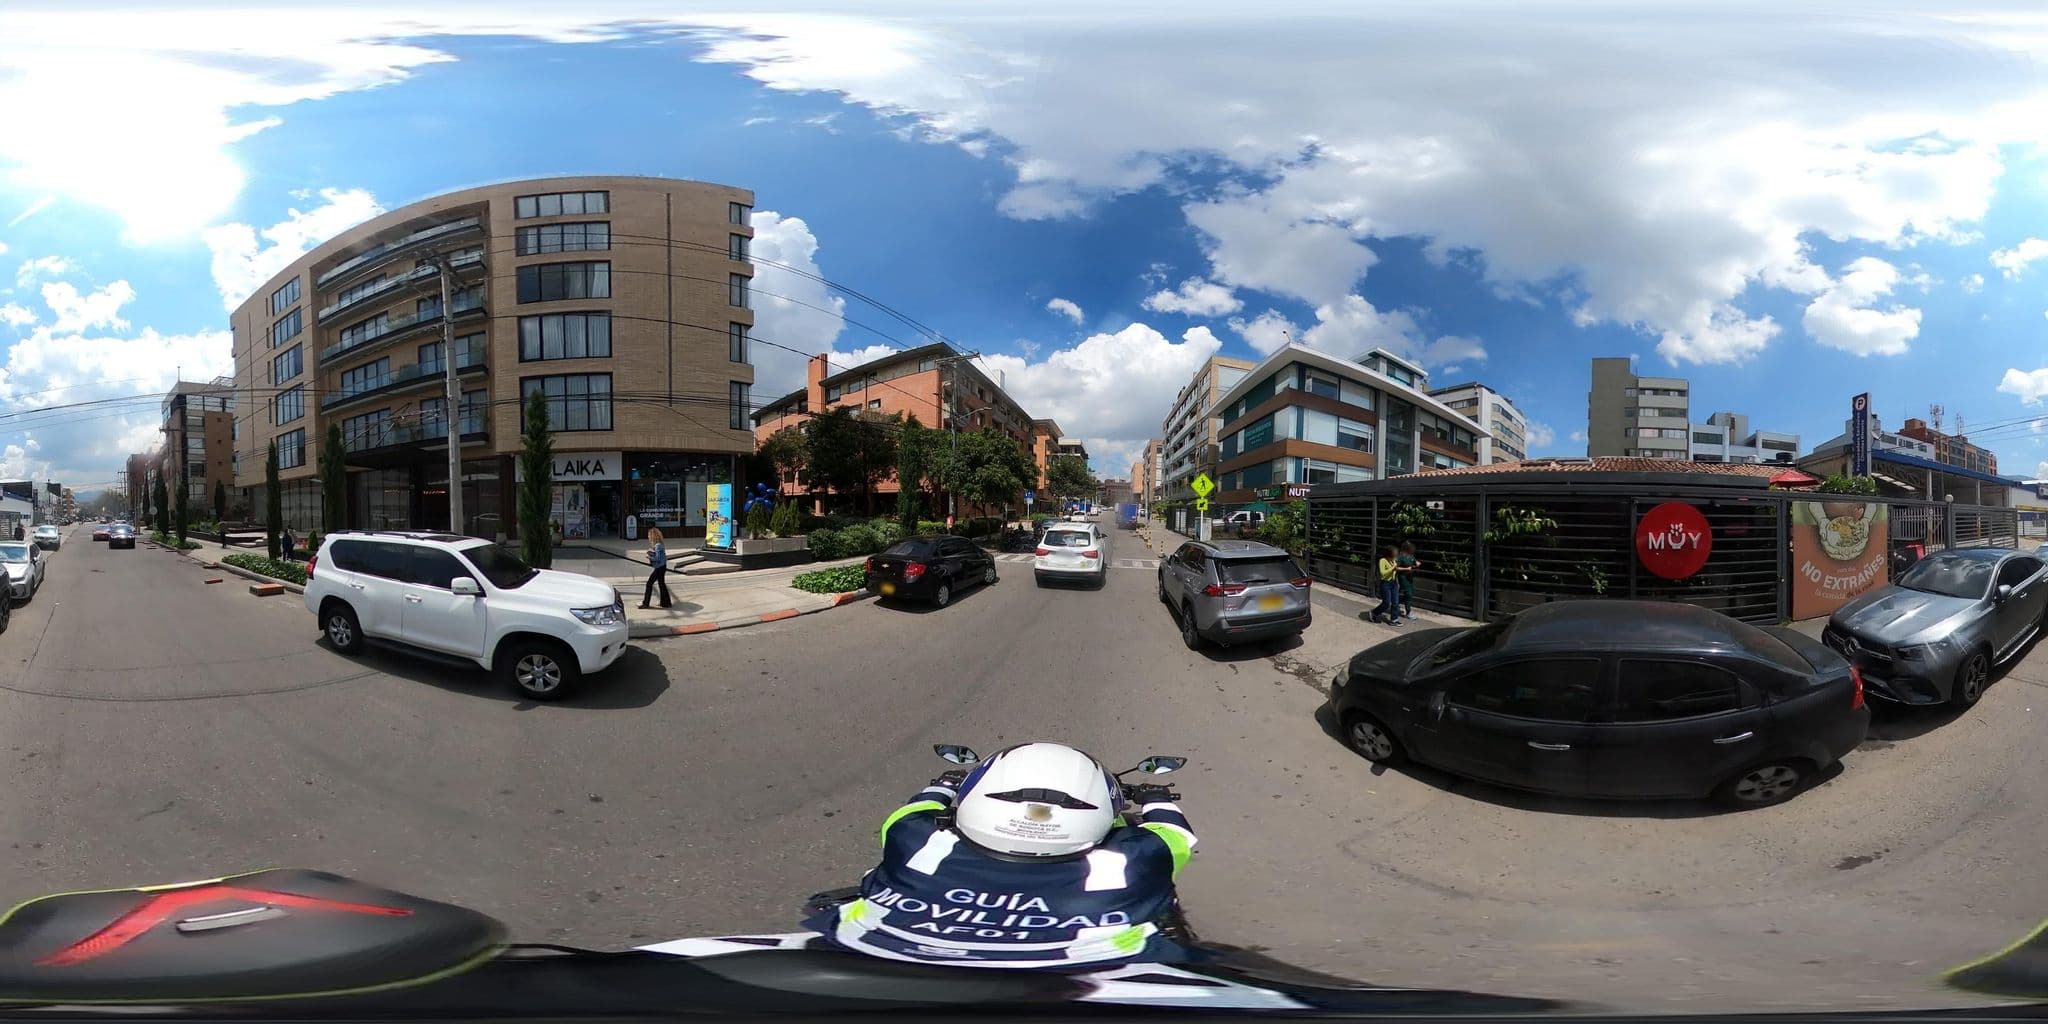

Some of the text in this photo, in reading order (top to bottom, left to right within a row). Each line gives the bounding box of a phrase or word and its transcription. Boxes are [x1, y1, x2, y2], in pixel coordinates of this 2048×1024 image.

[553, 460, 605, 476] LAIKA
[1648, 531, 1702, 550] MUY
[1801, 554, 1885, 590] NO EXTRAÑES
[869, 888, 1129, 928] MOVILIDAD
[944, 888, 1049, 912] GUÍA
[911, 922, 1031, 940] AF01
